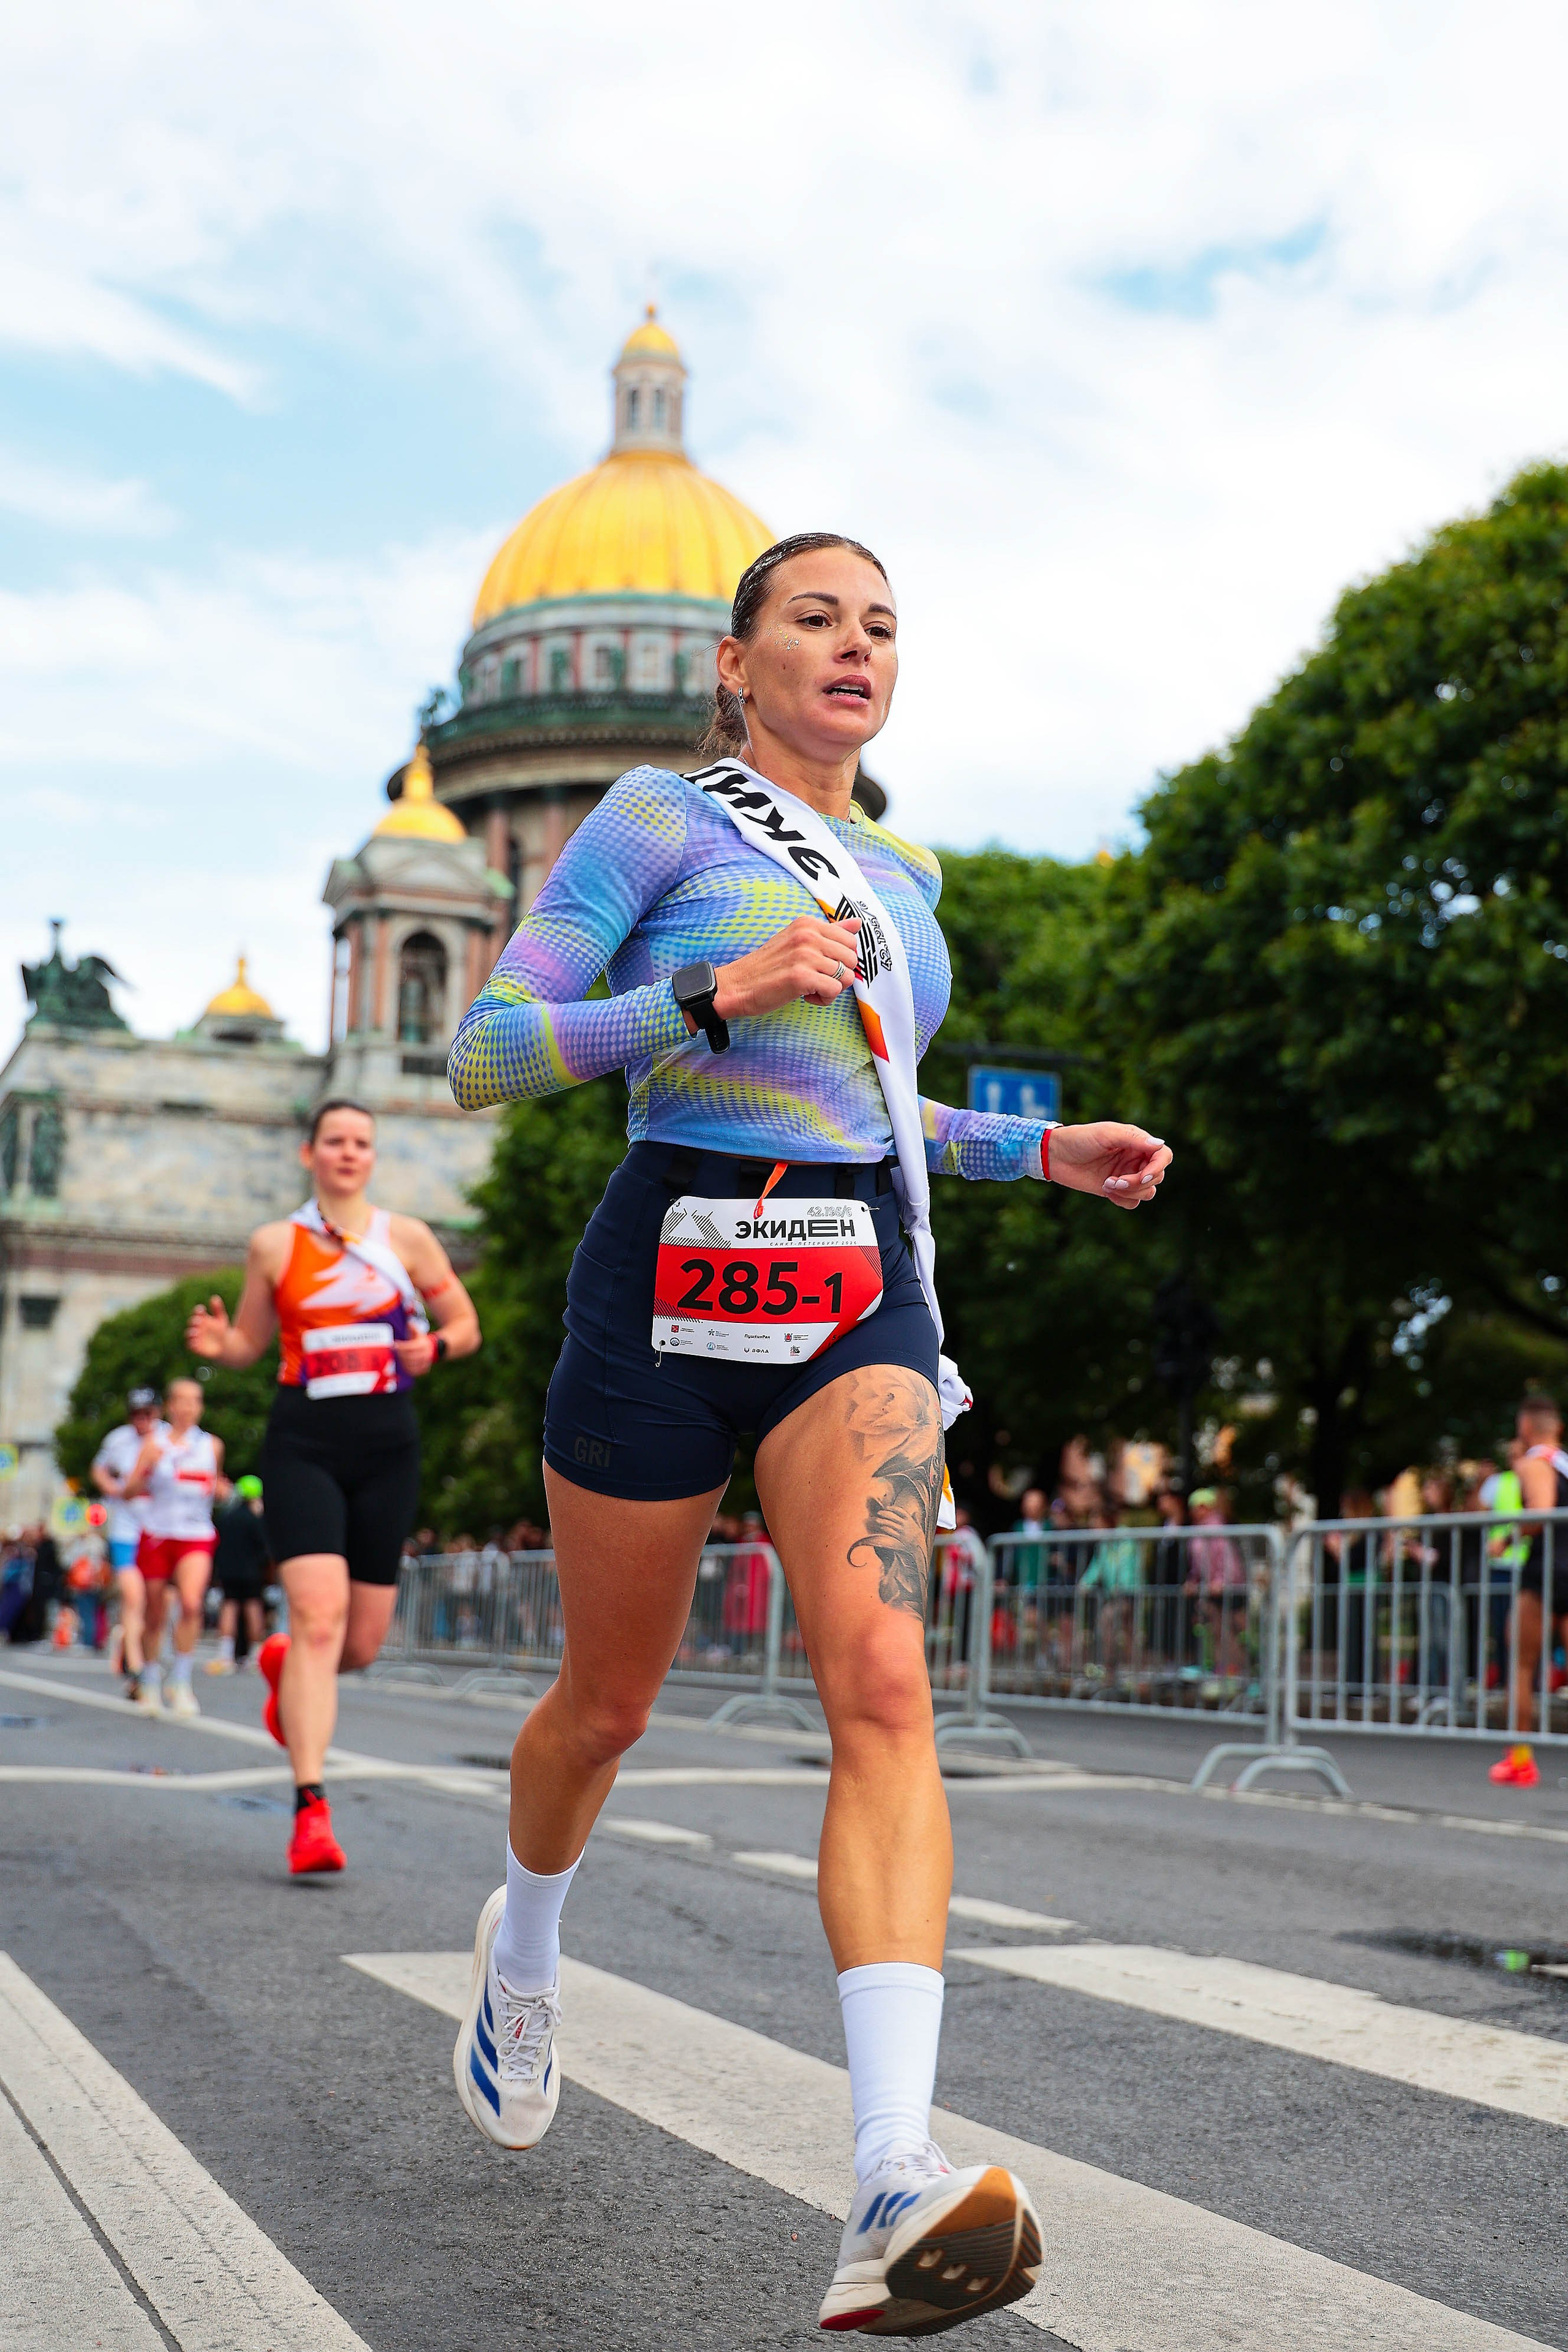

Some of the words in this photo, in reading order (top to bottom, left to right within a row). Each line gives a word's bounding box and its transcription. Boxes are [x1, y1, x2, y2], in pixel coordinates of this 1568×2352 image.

[807, 1206, 852, 1217] 42.195/6
[734, 1219, 855, 1241] ЭКИДЕН
[677, 1259, 843, 1314] 285-1
